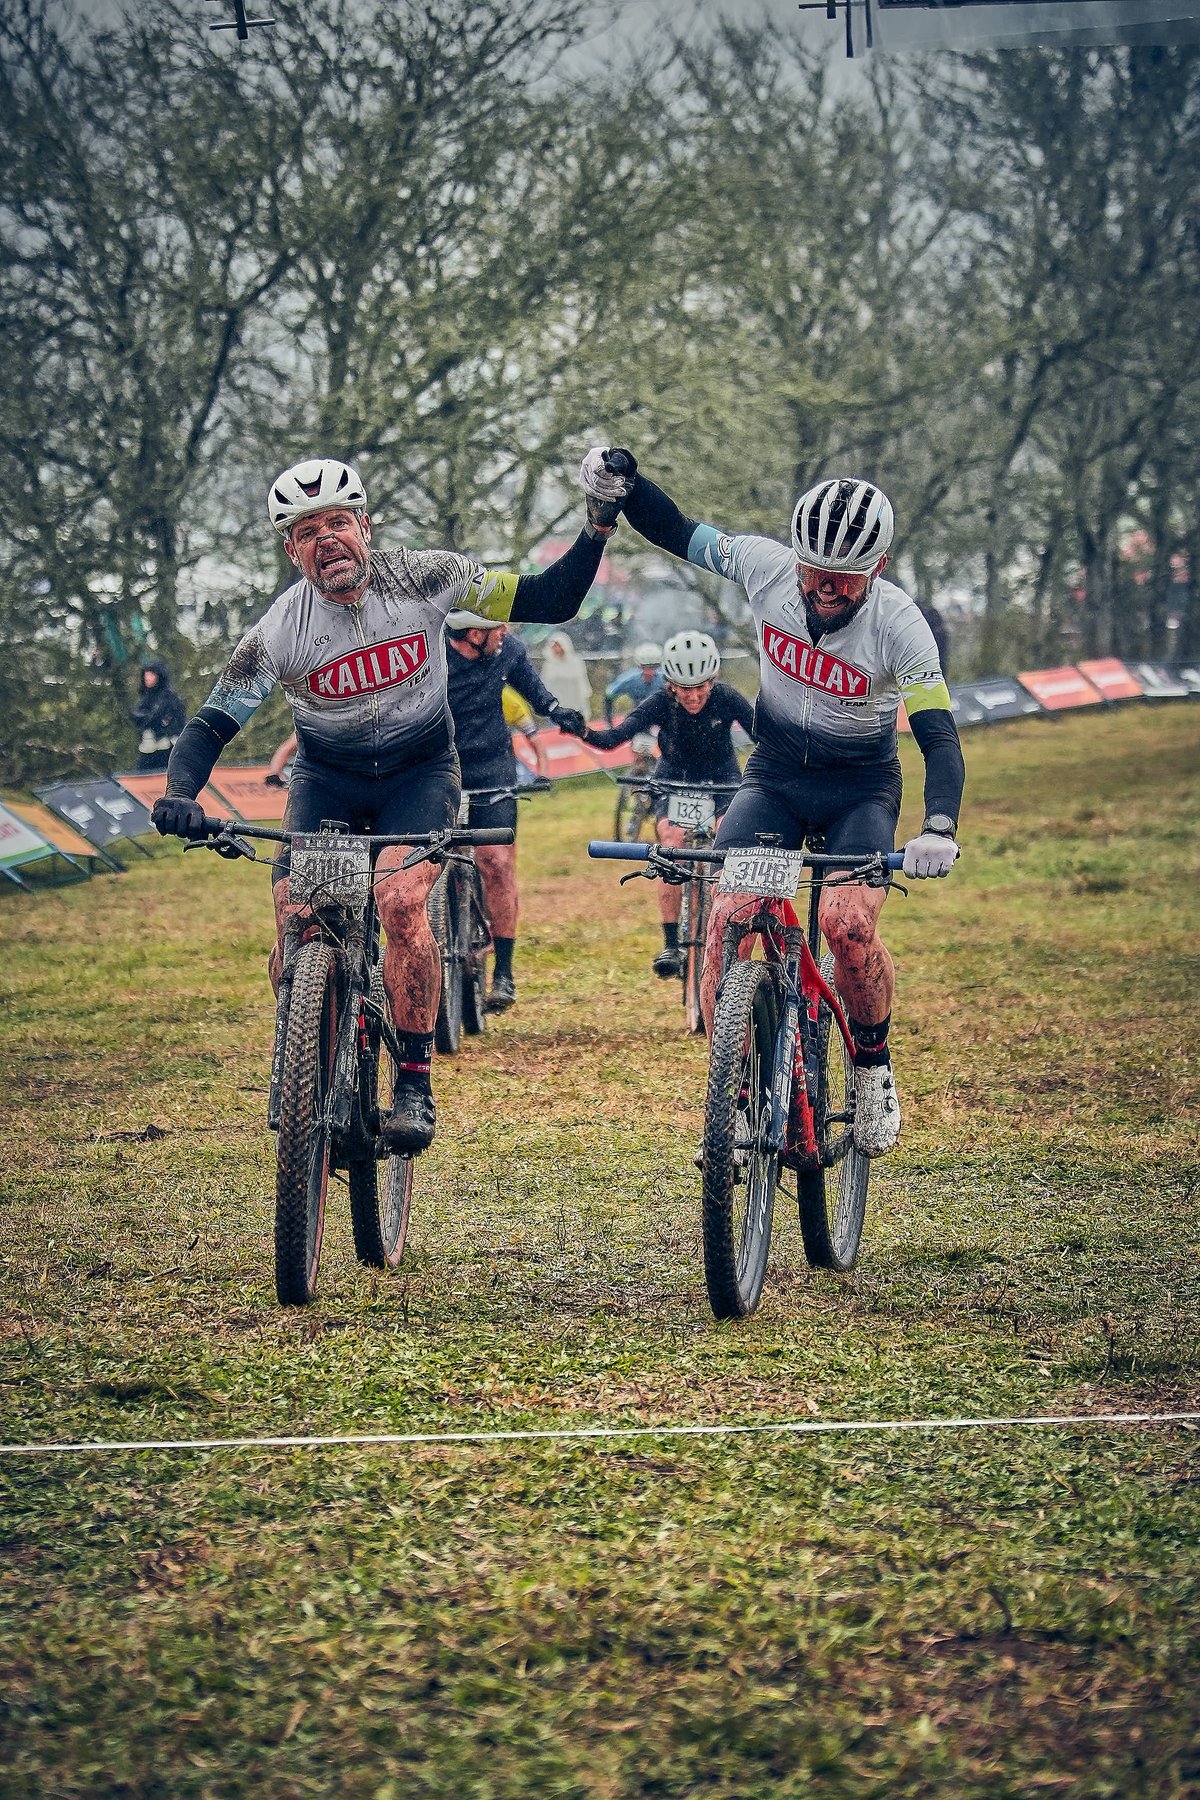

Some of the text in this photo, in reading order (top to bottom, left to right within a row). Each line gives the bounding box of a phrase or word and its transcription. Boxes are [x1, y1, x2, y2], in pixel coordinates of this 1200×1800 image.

[318, 640, 420, 695] KALLAY
[768, 633, 862, 693] KALLAY
[408, 666, 431, 688] TEAM
[840, 699, 868, 707] TEAM
[677, 801, 703, 820] 1325
[734, 861, 789, 883] 3146
